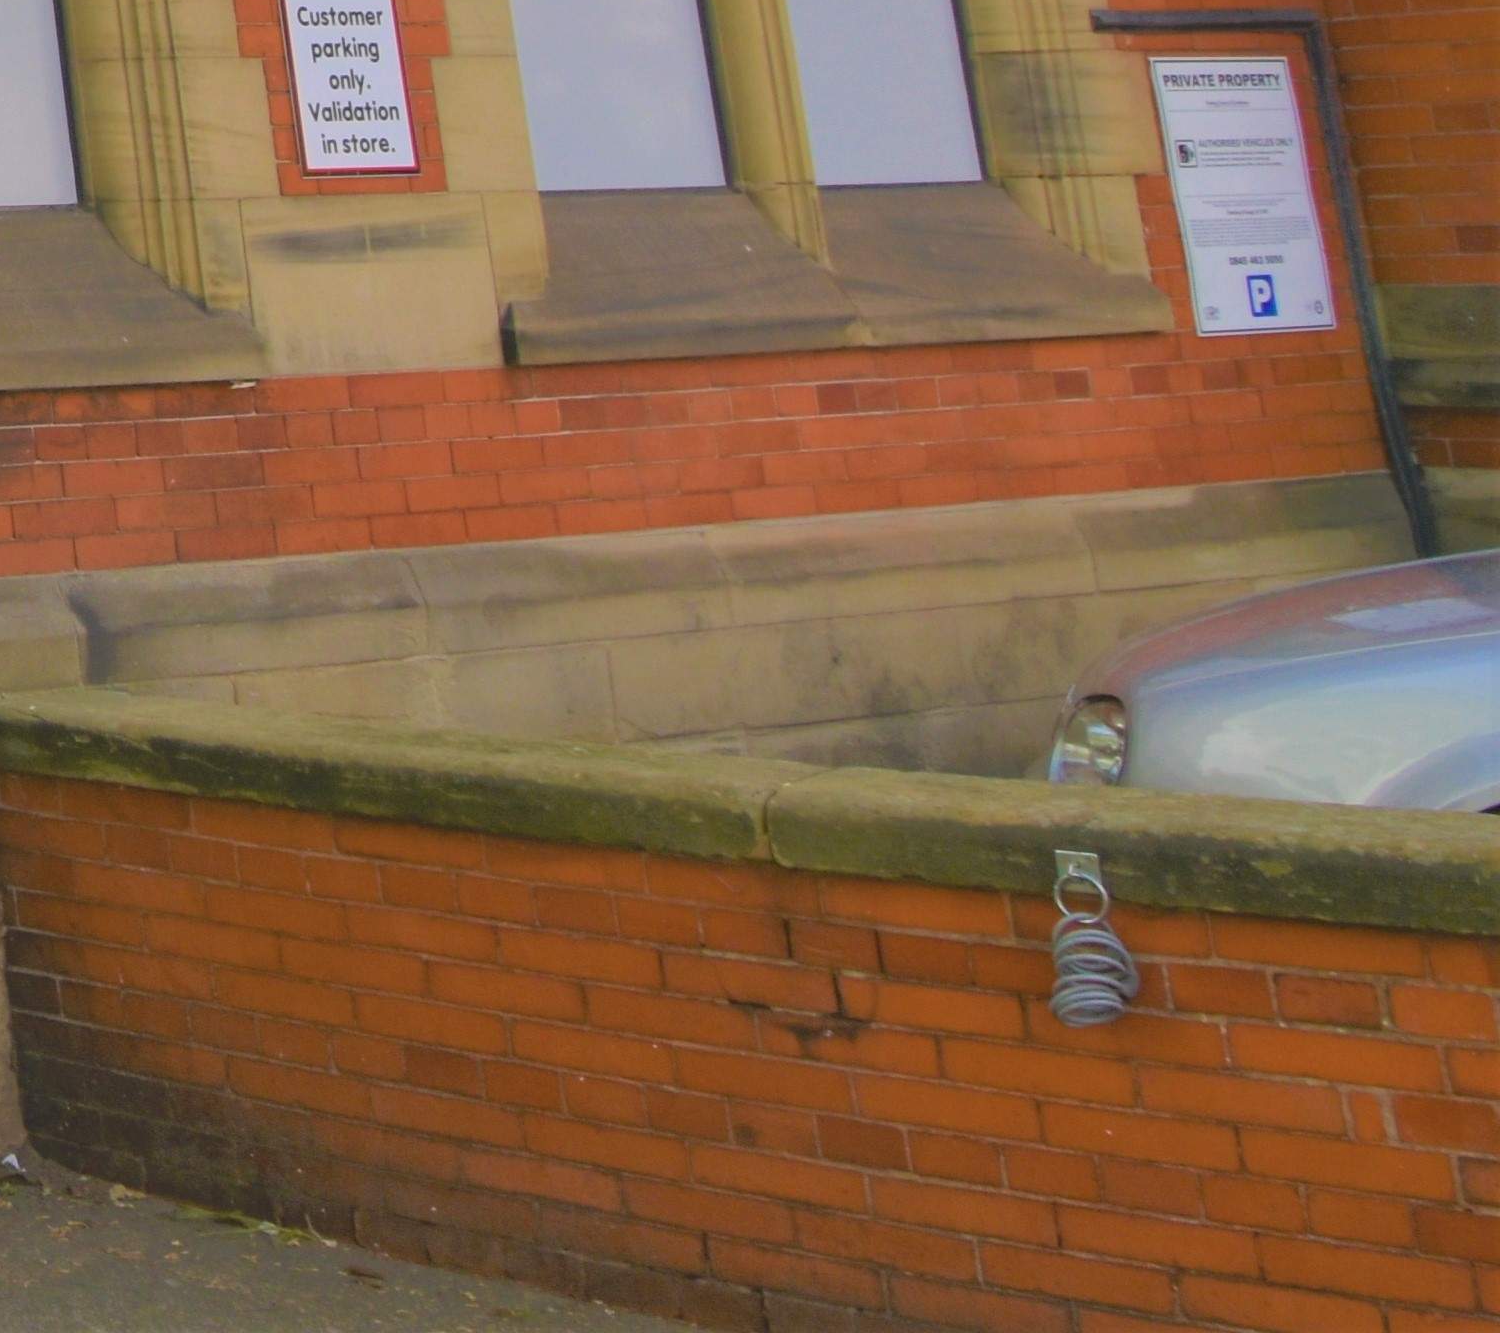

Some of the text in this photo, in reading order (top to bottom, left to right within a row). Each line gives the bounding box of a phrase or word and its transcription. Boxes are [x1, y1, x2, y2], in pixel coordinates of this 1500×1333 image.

[297, 5, 383, 27] Customer
[310, 37, 380, 63] parking
[328, 68, 371, 95] only.
[1162, 73, 1280, 88] PRIVATE PROPERTY
[307, 100, 400, 123] Validation
[321, 133, 396, 154] in store.
